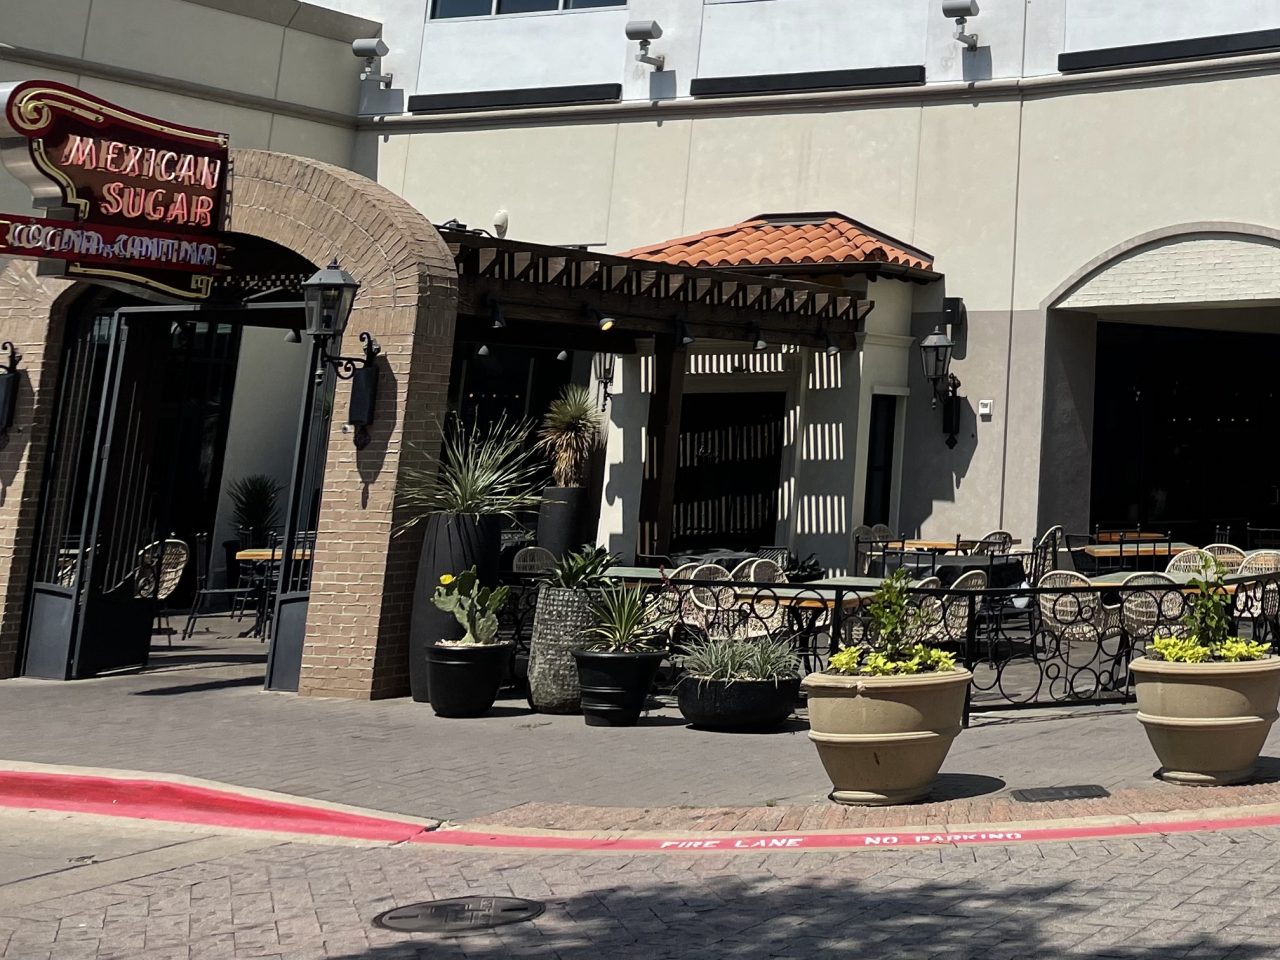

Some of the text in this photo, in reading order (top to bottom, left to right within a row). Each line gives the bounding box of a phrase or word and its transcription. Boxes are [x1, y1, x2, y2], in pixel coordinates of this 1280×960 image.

[61, 134, 221, 190] MEXICAN
[100, 182, 214, 228] SUGAR
[6, 222, 102, 255] COCINA
[113, 233, 217, 266] CANTINA
[660, 832, 1022, 849] FIRE LANE NO PARKING
